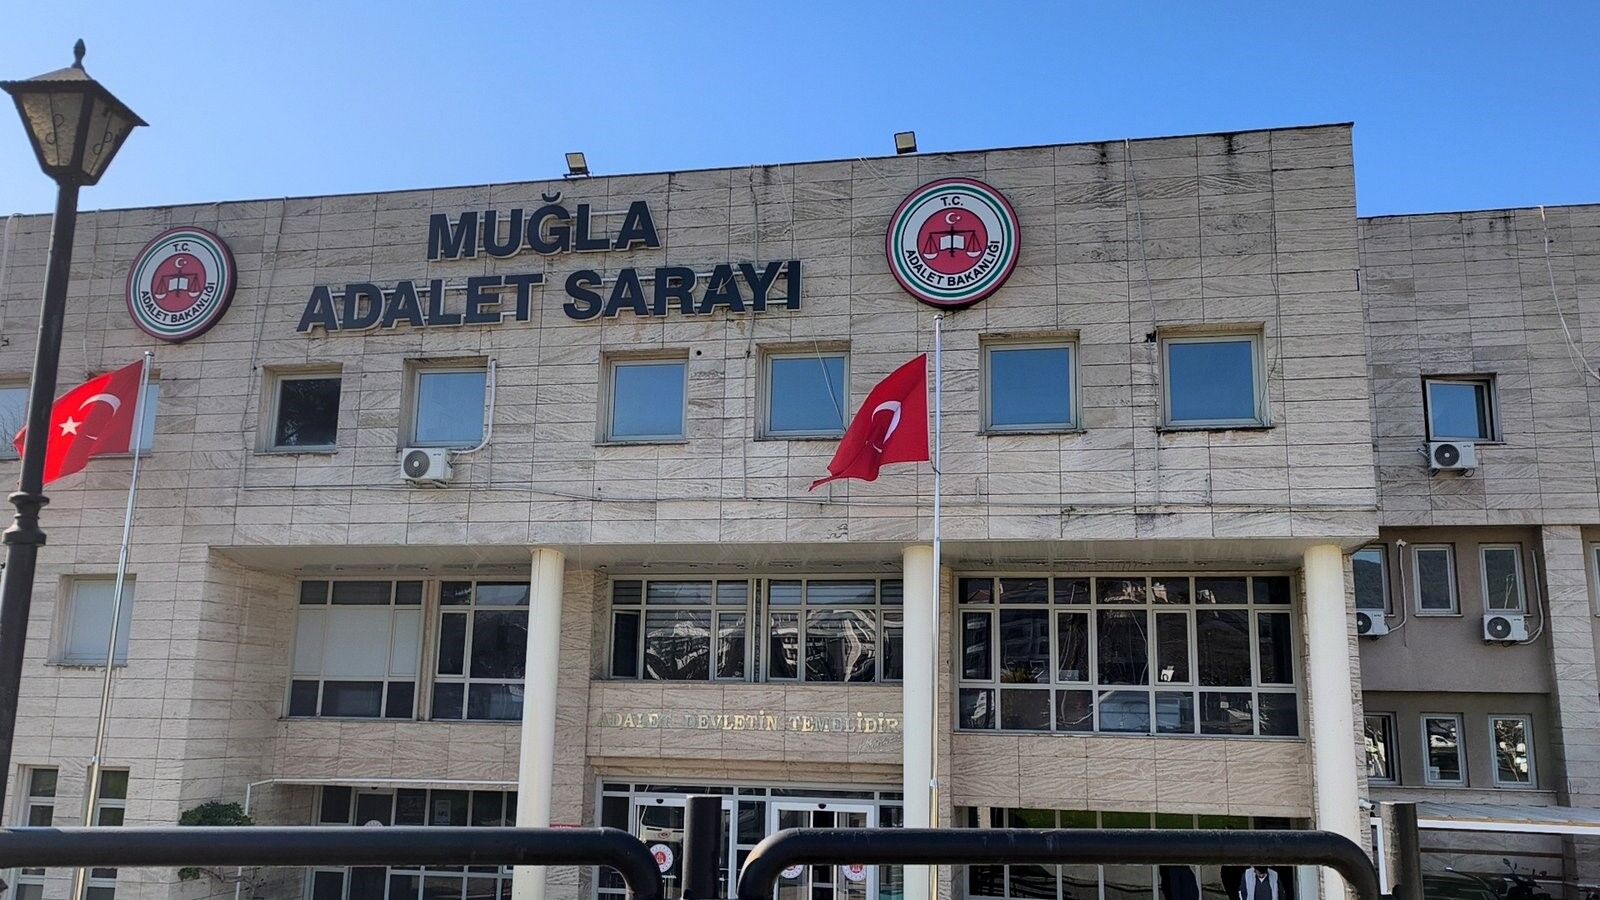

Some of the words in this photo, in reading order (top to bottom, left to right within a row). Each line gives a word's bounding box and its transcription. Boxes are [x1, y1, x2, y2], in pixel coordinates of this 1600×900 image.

[940, 196, 963, 206] T.C.
[173, 242, 191, 252] T.C.
[427, 191, 662, 262] MUĞLA
[906, 250, 944, 285] ADALET
[947, 240, 1000, 286] BAKANLIĞI
[141, 290, 170, 322] ADALET
[170, 281, 216, 323] BAKANLIĞI
[296, 273, 545, 333] ADALET
[563, 260, 802, 322] SARAYI
[599, 711, 672, 729] ADALET
[684, 709, 779, 731] DEVLETİN
[789, 711, 900, 734] TEMELİDİR
